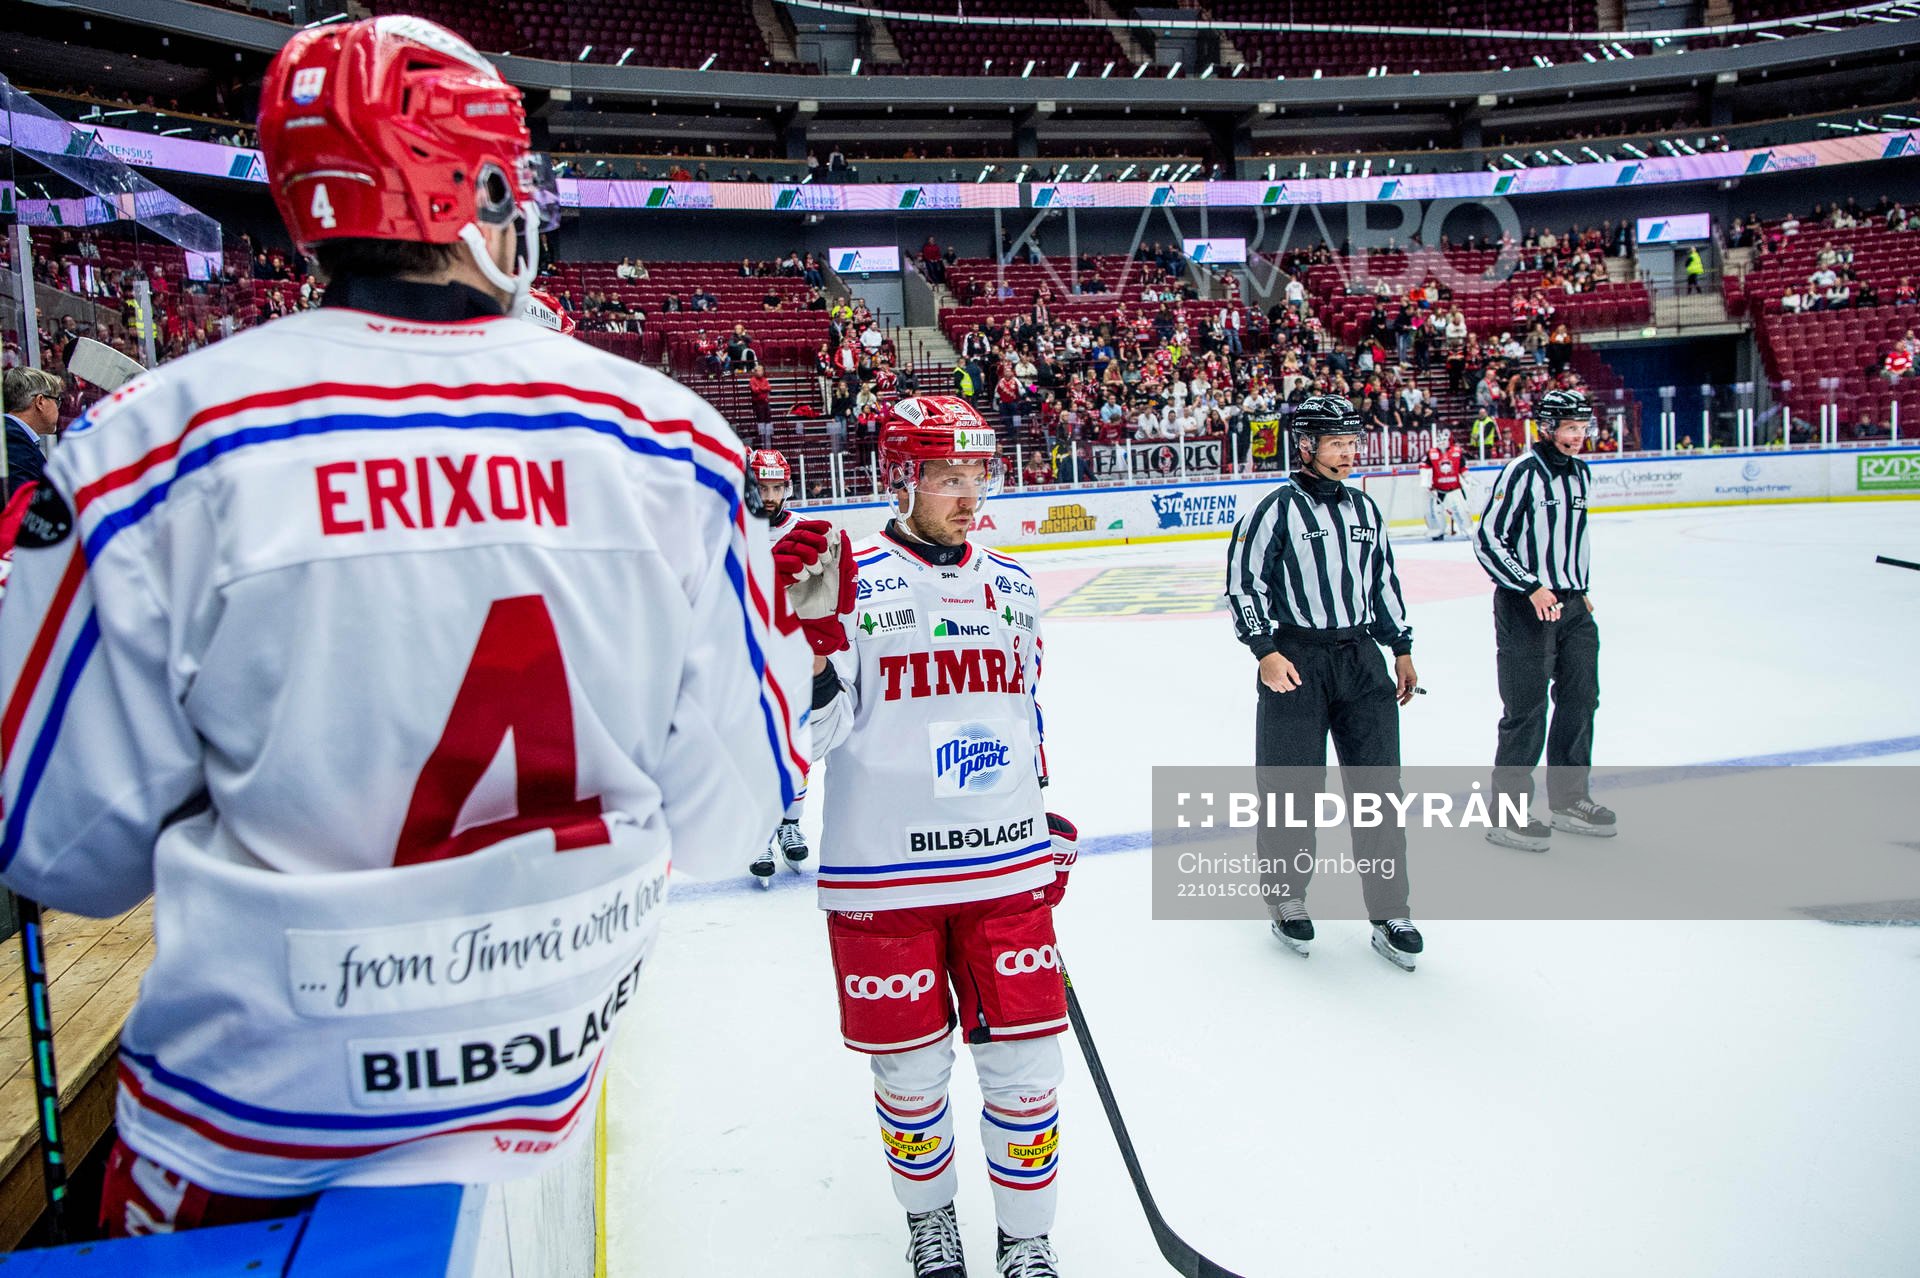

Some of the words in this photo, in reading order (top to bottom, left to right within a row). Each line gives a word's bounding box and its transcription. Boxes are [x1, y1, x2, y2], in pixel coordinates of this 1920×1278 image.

[312, 183, 337, 228] 4
[315, 454, 568, 536] ERIXON
[1574, 498, 1588, 509] SH
[1048, 504, 1086, 520] EURO
[1183, 511, 1214, 527] TELE
[1217, 510, 1236, 524] AB
[1039, 516, 1097, 535] JACKPOT
[1303, 530, 1328, 540] CCM
[875, 577, 909, 592] SCA
[1013, 581, 1036, 598] SCA
[984, 583, 997, 611] A
[879, 608, 916, 629] LILIUM
[960, 625, 990, 636] NHC
[879, 635, 1026, 701] TIMRÅ
[391, 593, 612, 868] 4
[936, 739, 1009, 778] Miami
[959, 746, 1011, 789] pool
[911, 818, 1034, 852] BILBOLAGET
[336, 945, 436, 1008] from
[447, 917, 564, 985] Timrå
[573, 890, 629, 952] with
[844, 968, 936, 1001] coop
[362, 958, 644, 1093] BILBOLAGET
[890, 1094, 925, 1102] BAUER
[884, 1134, 933, 1152] SUNDFRAKT
